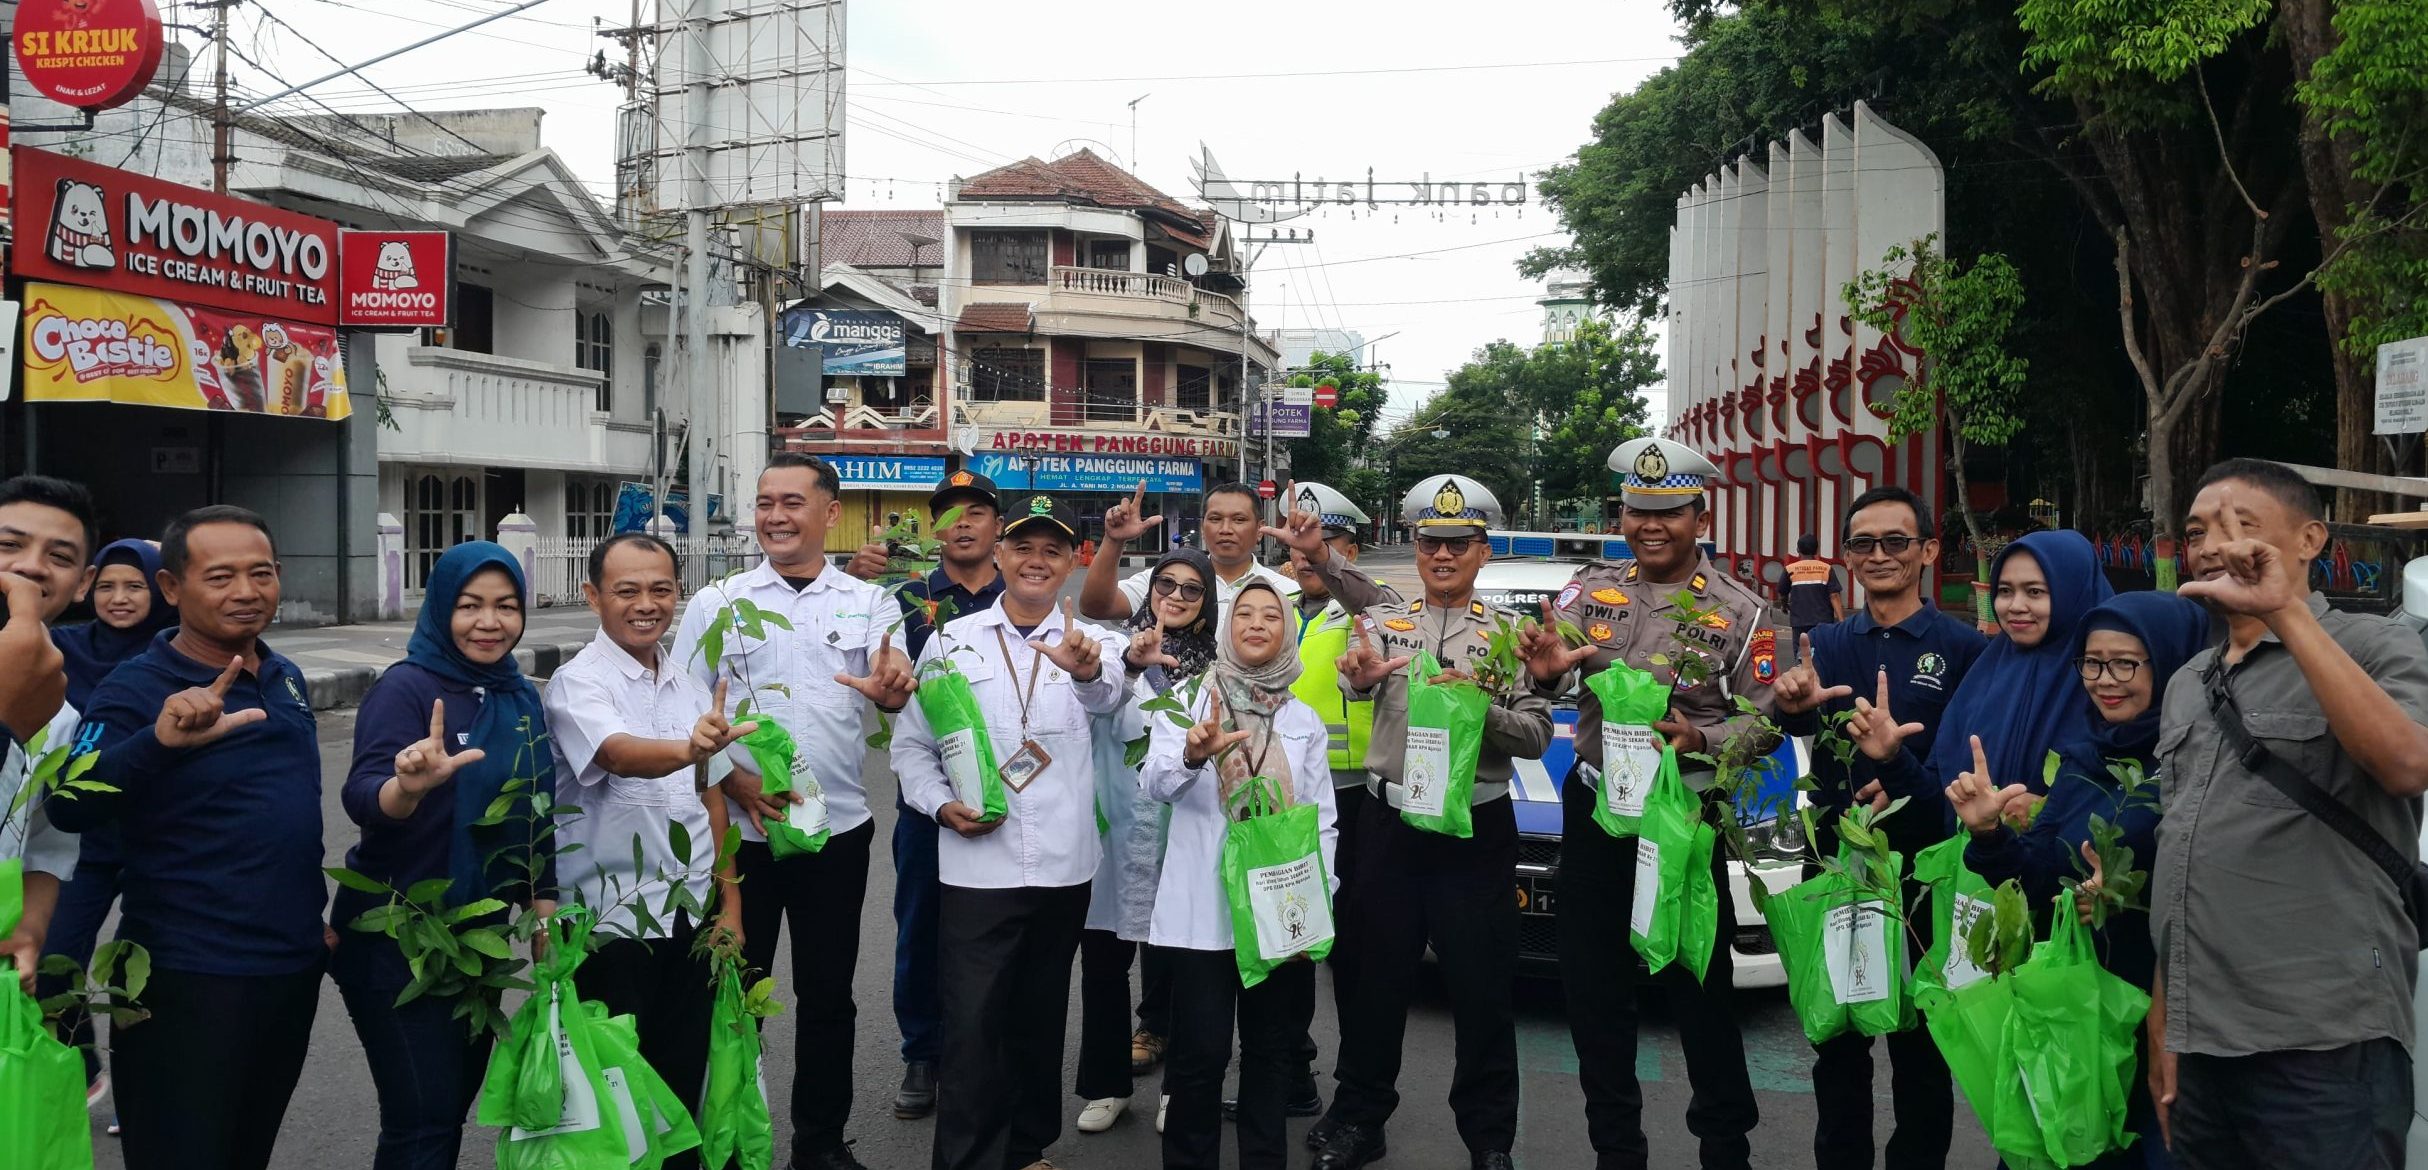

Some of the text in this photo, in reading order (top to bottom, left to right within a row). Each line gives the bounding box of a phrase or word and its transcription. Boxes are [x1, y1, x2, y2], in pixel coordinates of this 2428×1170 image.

[22, 28, 138, 56] SI KRIUK
[36, 55, 124, 68] KRISPI CHICKEN
[55, 82, 107, 97] ENAK & LEZAT
[129, 192, 328, 280] MOMOYO
[129, 252, 326, 305] ICE CREAM & FRUIT TEA
[351, 292, 435, 308] MOMOYO
[33, 316, 127, 360] Choco
[833, 325, 901, 341] mangga
[1266, 408, 1303, 417] POTEK
[992, 431, 1241, 460] APOTEK PANGGUNG FARMA
[1007, 454, 1195, 477] APOTEK PANGGUNG FARMA
[1040, 473, 1068, 481] HEMAT
[1074, 474, 1111, 482] LENGKAP
[1481, 593, 1549, 604] POLRES
[1584, 604, 1629, 622] DWI.P
[1675, 622, 1727, 650] POLRI
